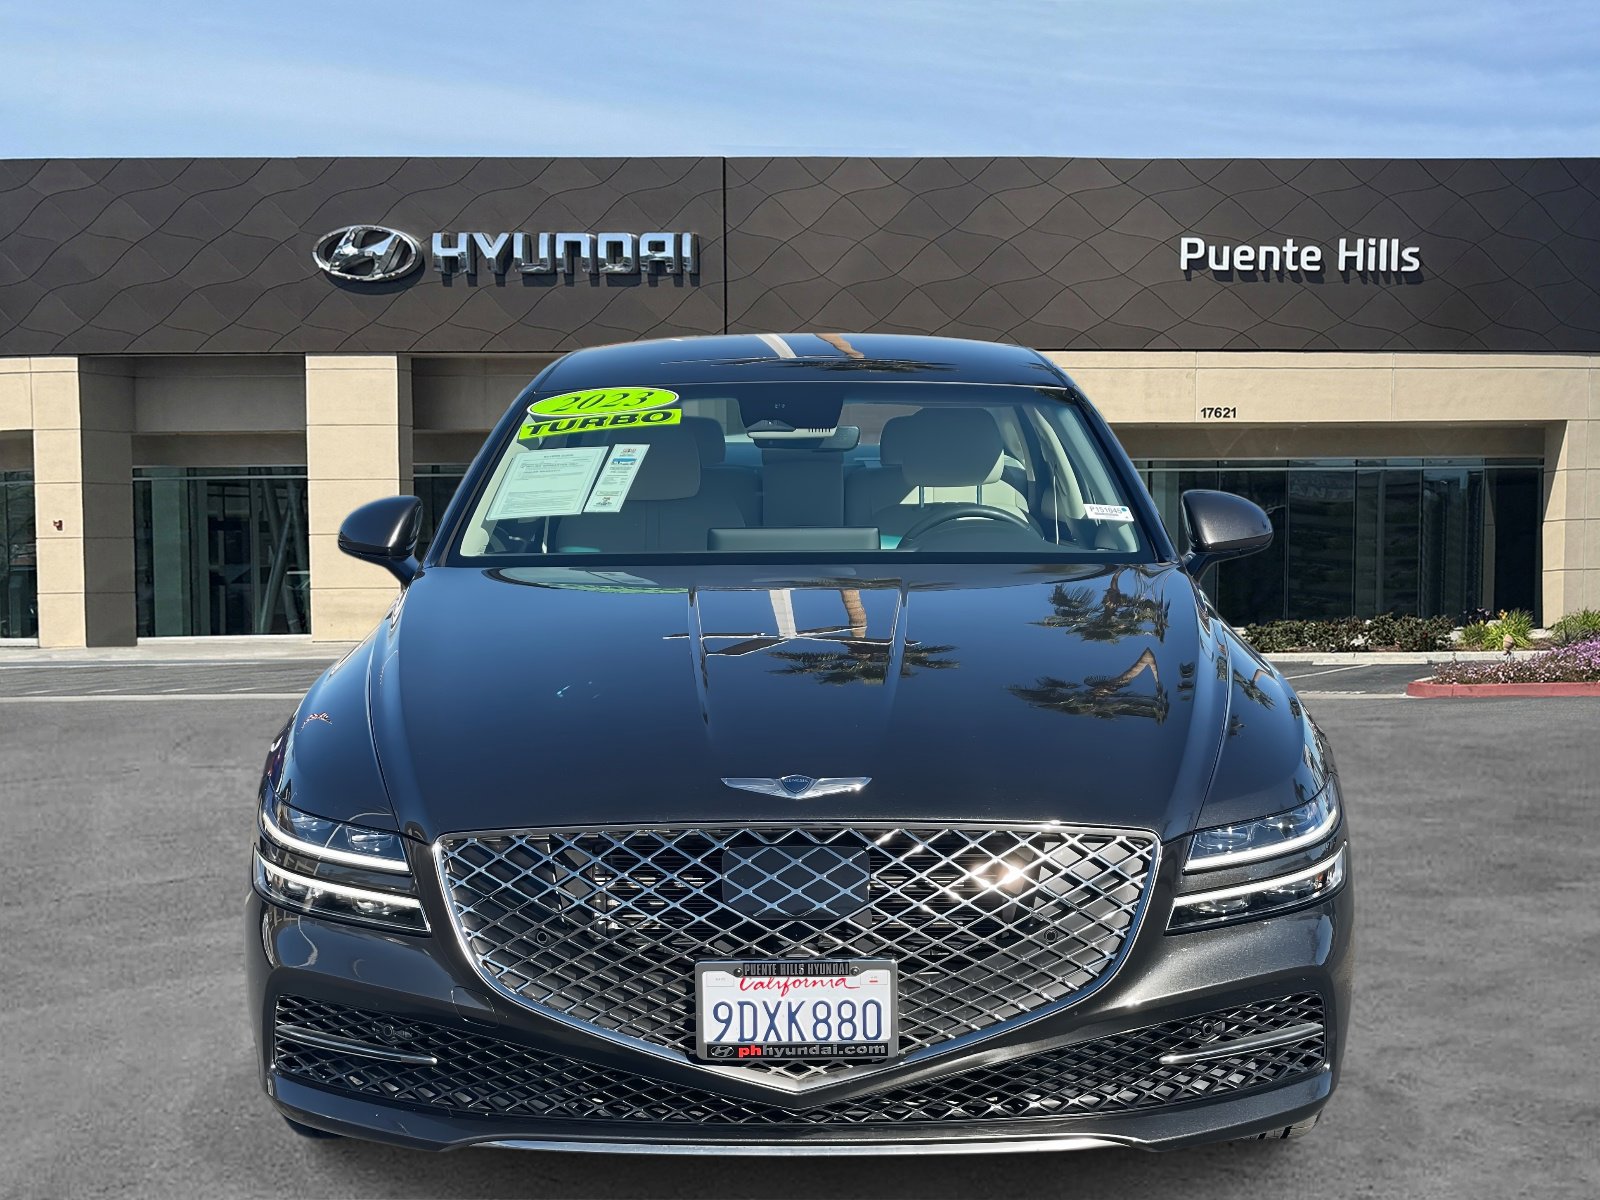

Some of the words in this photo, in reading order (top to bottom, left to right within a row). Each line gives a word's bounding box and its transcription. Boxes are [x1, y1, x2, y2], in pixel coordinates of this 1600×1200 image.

[432, 232, 700, 274] HYUNDAI
[1180, 238, 1322, 271] Puente
[1338, 237, 1420, 272] Hills
[552, 391, 655, 412] 2023
[527, 411, 674, 435] TURBO
[1200, 407, 1237, 418] 17621
[744, 963, 777, 976] PUENTE
[780, 963, 805, 976] HILLS
[807, 962, 848, 975] HYUNDAI
[740, 976, 860, 997] California
[713, 999, 882, 1041] 9DXK880
[738, 1044, 886, 1057] phhyundai.com
